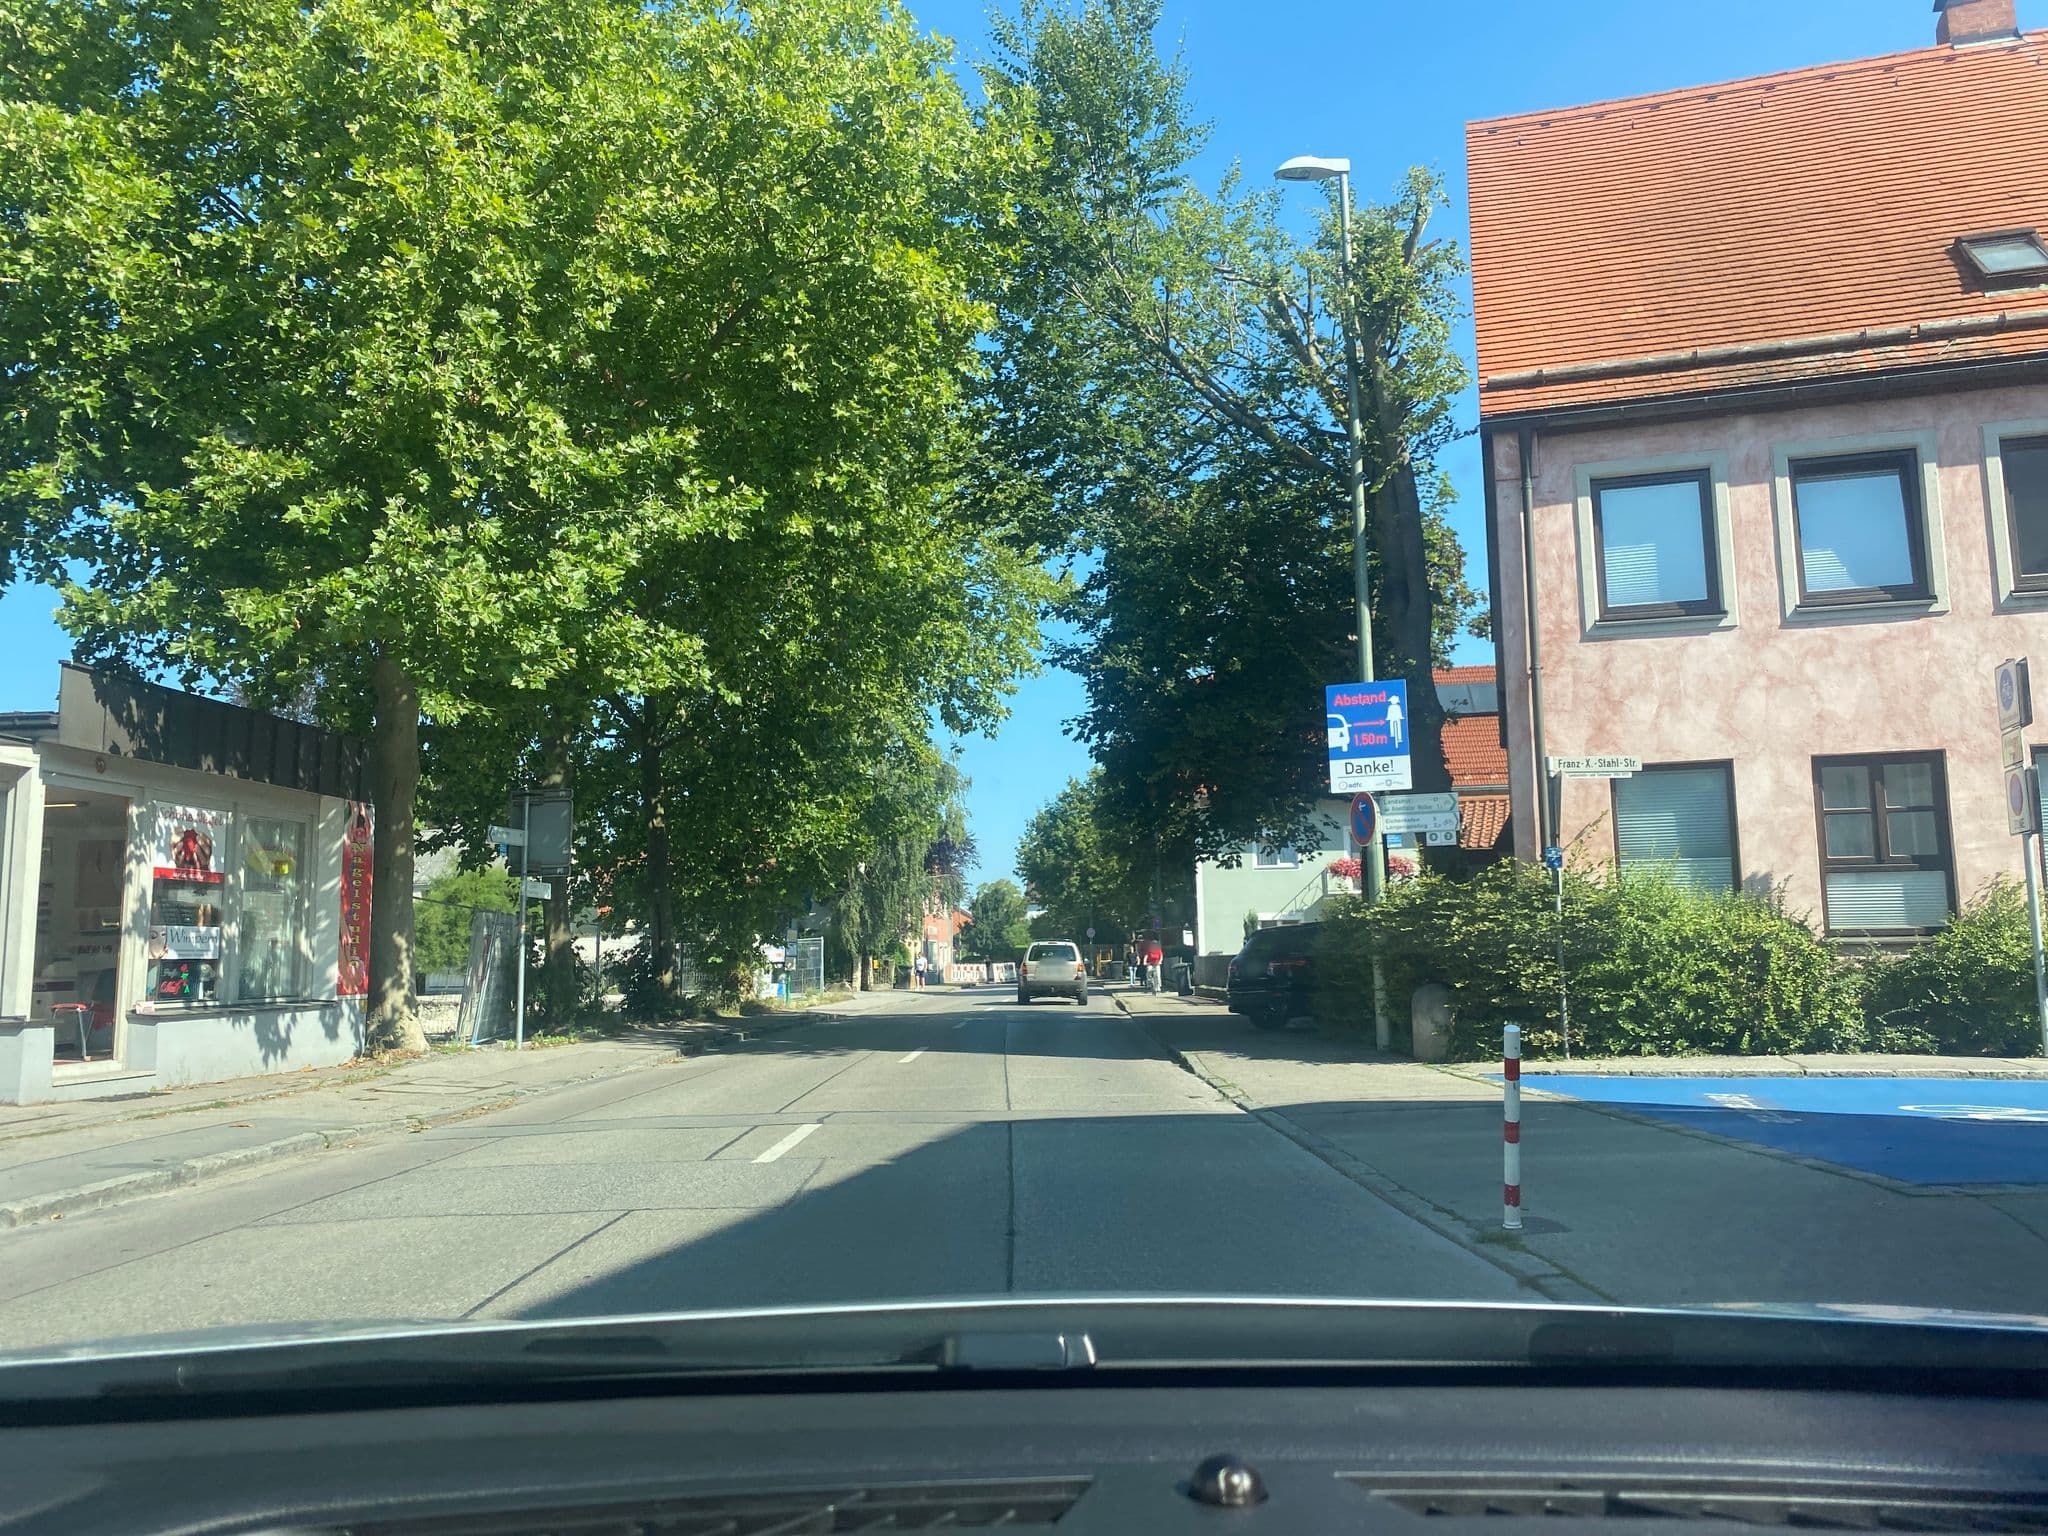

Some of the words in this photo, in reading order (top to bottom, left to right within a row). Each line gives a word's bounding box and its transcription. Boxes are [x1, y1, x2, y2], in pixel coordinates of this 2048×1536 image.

[1333, 691, 1387, 706] Abstand
[1344, 760, 1395, 775] Danke!
[1558, 758, 1637, 768] Franz-X.-Stahl-Str.
